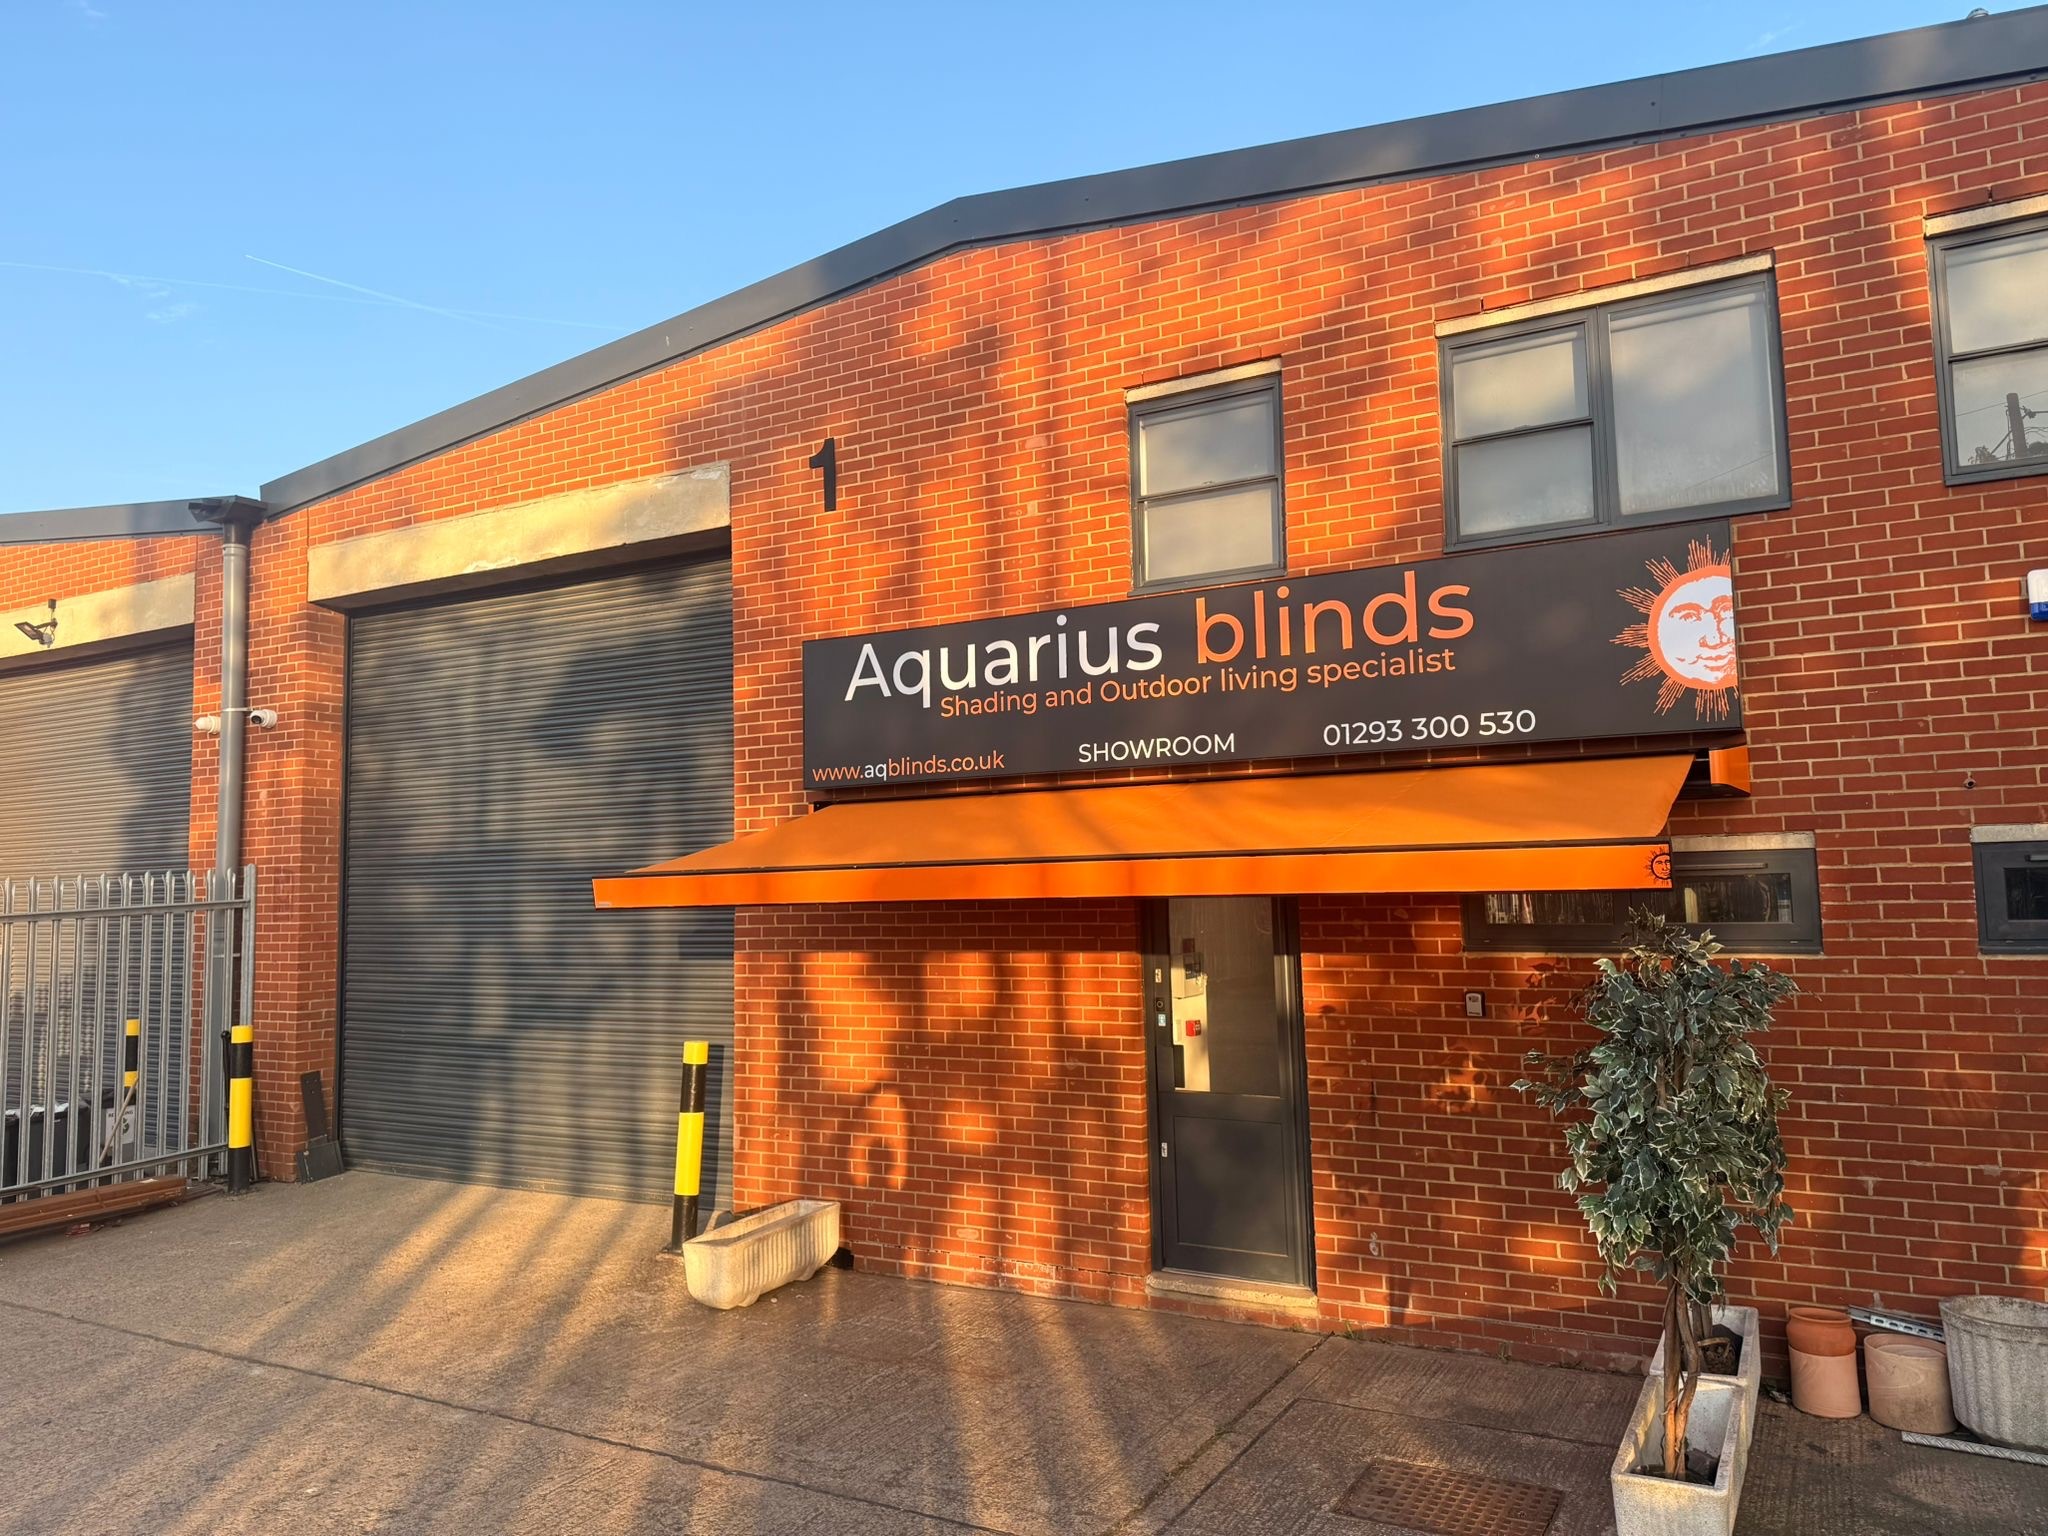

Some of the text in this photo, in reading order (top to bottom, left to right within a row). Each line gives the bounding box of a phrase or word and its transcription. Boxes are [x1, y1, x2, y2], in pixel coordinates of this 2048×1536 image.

[808, 437, 837, 513] 1
[844, 569, 1475, 709] Aquarius blinds
[940, 647, 1457, 718] Shading and Outdoor living specialist
[1078, 732, 1236, 763] SHOWROOM
[1322, 709, 1537, 747] 01293 300 530
[812, 749, 1005, 782] www.aqblinds.co.uk
